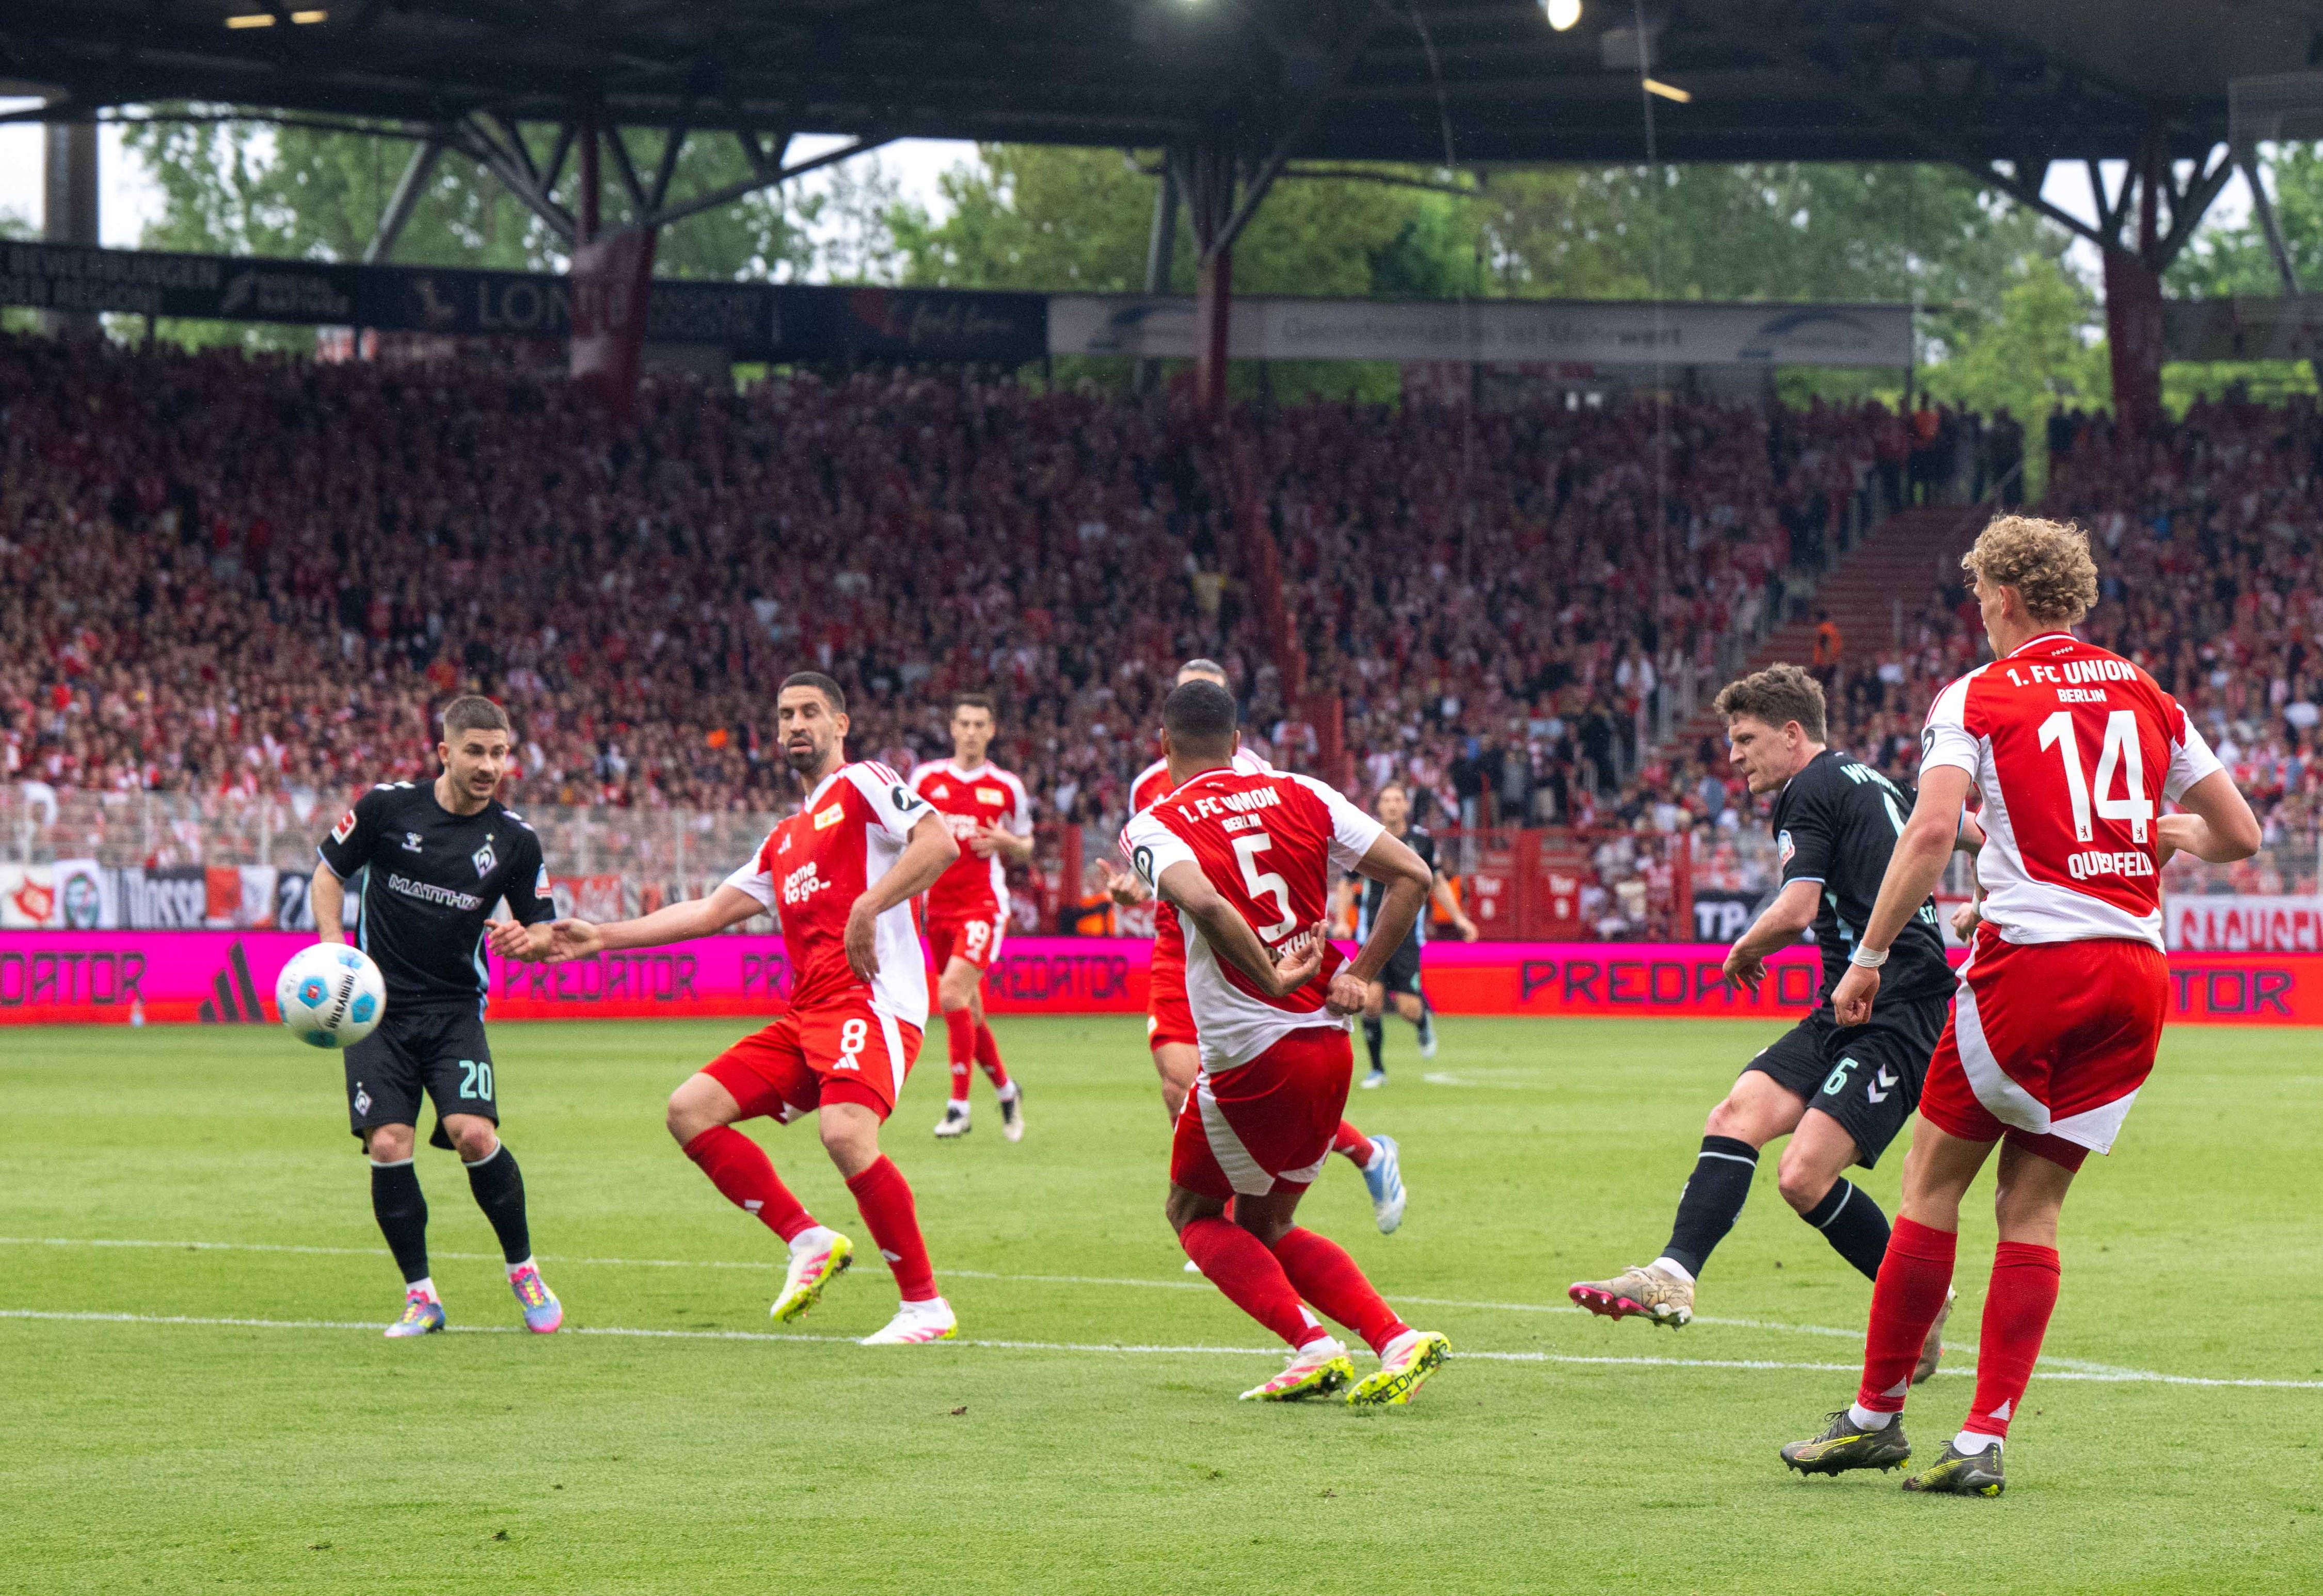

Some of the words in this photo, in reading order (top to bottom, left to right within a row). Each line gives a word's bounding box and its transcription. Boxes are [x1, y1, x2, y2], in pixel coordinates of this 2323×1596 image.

[2006, 668, 2029, 687] 1.
[2029, 665, 2061, 683] FC
[2063, 660, 2138, 684] UNION
[2056, 689, 2107, 702] BERLIN
[2038, 710, 2154, 843] 14
[1178, 805, 1199, 823] 1.
[1194, 796, 1224, 819] FC
[1221, 813, 1263, 833] BERLIN
[1231, 833, 1297, 943] 5
[964, 920, 991, 949] 19
[504, 953, 698, 1001] PREDATOR
[326, 975, 355, 1029] DERBYSTAR
[840, 1018, 868, 1054] 8
[459, 1060, 492, 1102] 20
[1823, 1057, 1858, 1095] 6
